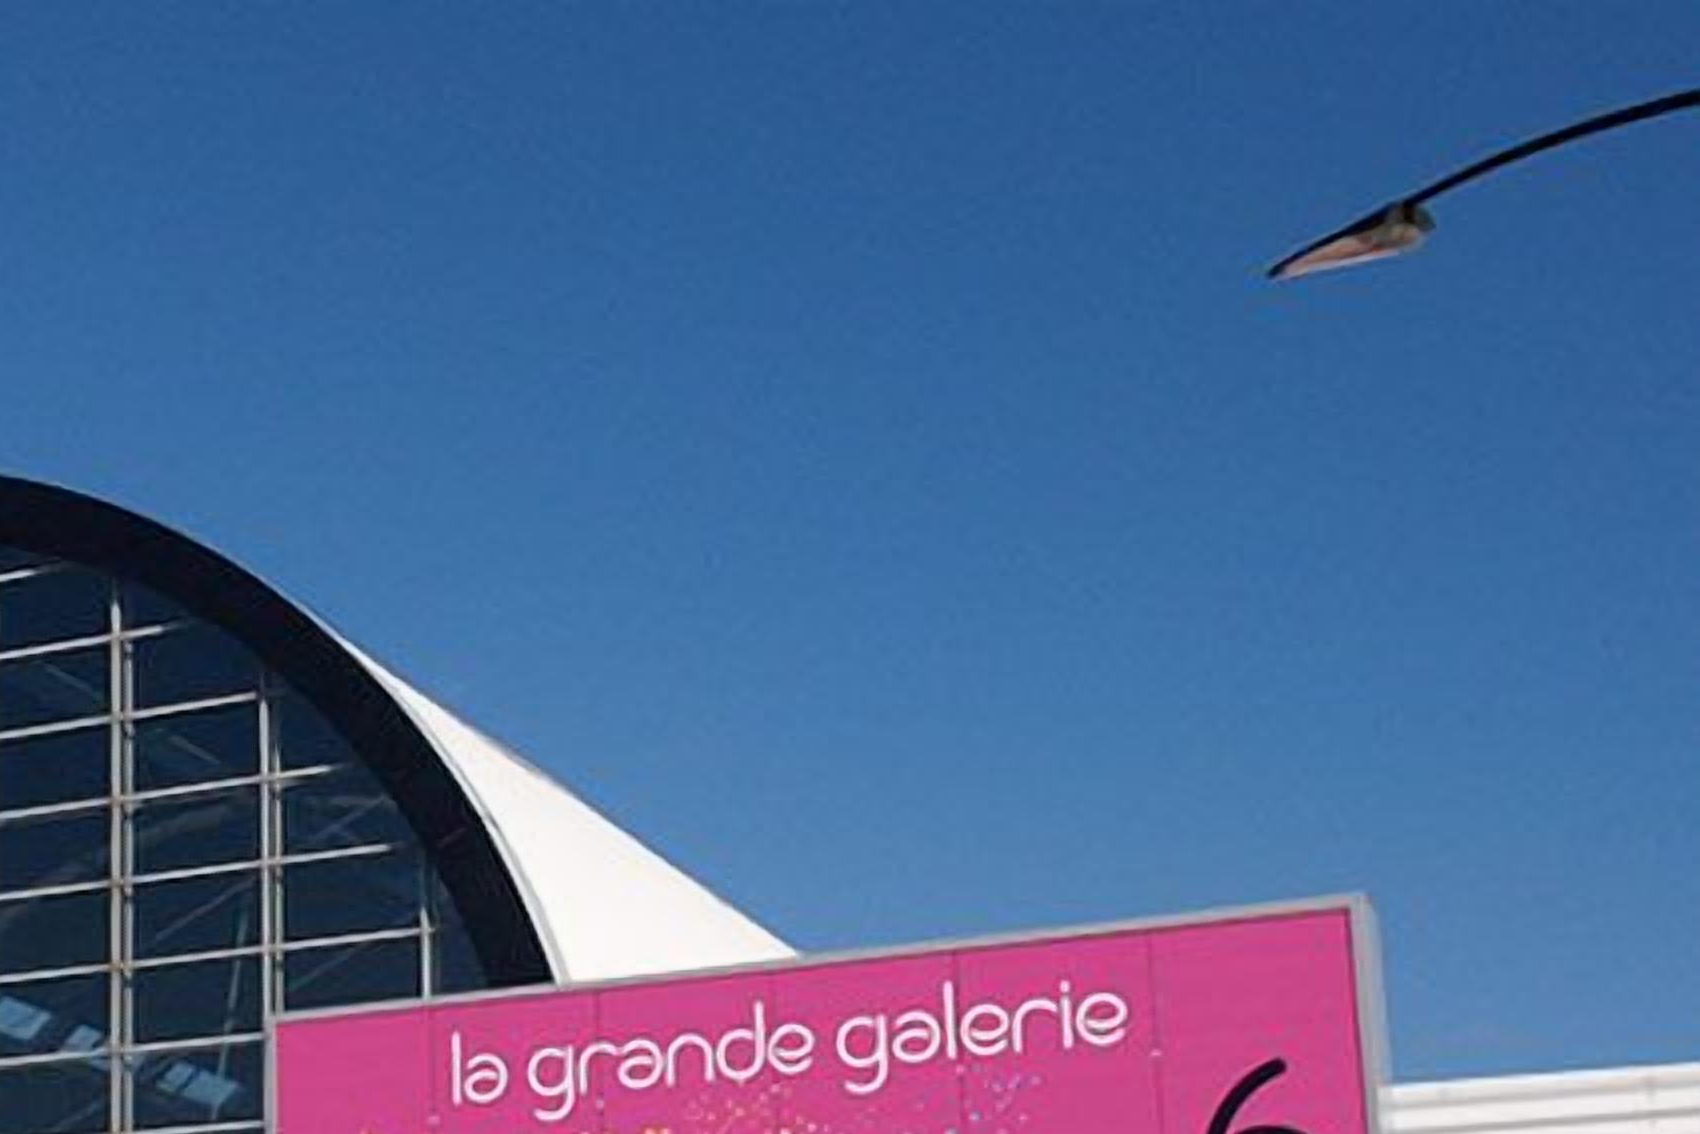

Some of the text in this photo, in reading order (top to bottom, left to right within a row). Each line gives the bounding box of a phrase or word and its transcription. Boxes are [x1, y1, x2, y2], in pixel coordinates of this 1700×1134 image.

[450, 981, 1128, 1121] la grande galerie
